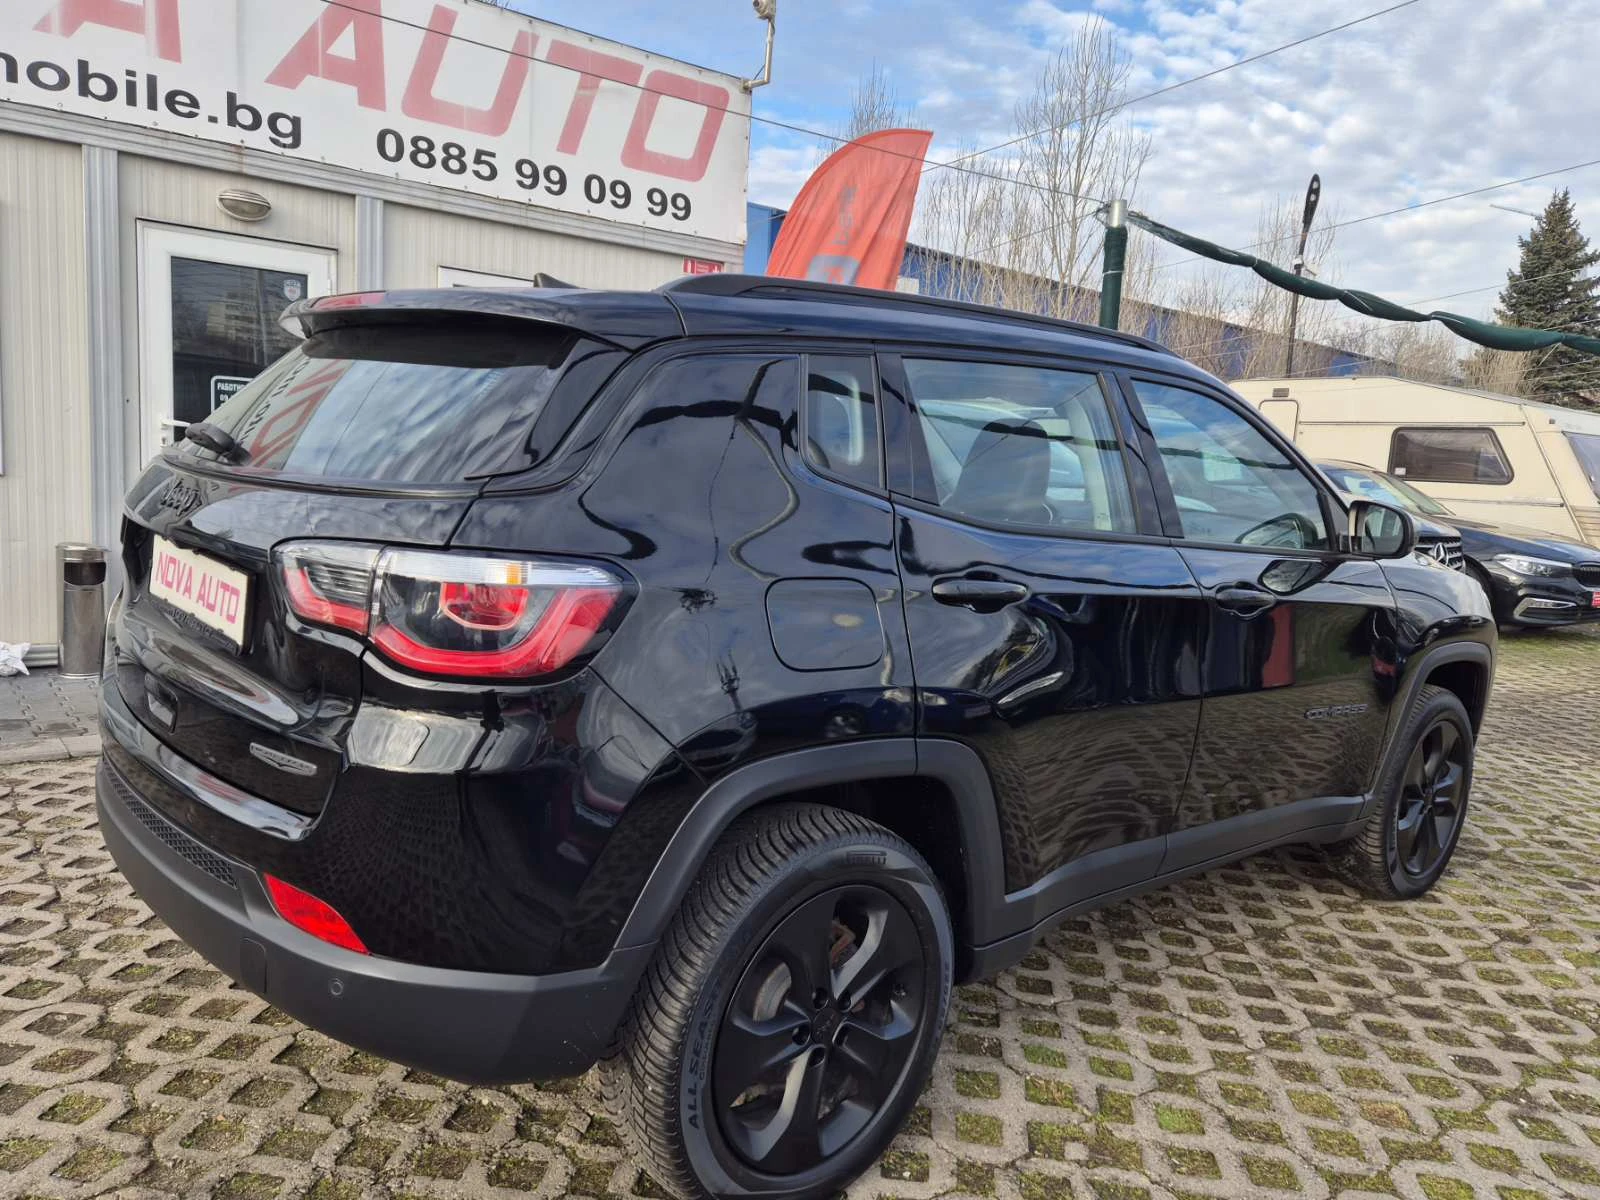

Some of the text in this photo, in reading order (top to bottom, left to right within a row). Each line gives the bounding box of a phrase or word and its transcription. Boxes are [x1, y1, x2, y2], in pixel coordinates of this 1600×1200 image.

[264, 0, 730, 182] AUTO
[376, 128, 498, 181] 0885
[515, 158, 568, 196] 99
[584, 174, 632, 209] 09
[646, 187, 692, 221] 99
[155, 551, 193, 600] NOVA
[195, 572, 241, 625] AUTO
[687, 1082, 700, 1130] ALL
